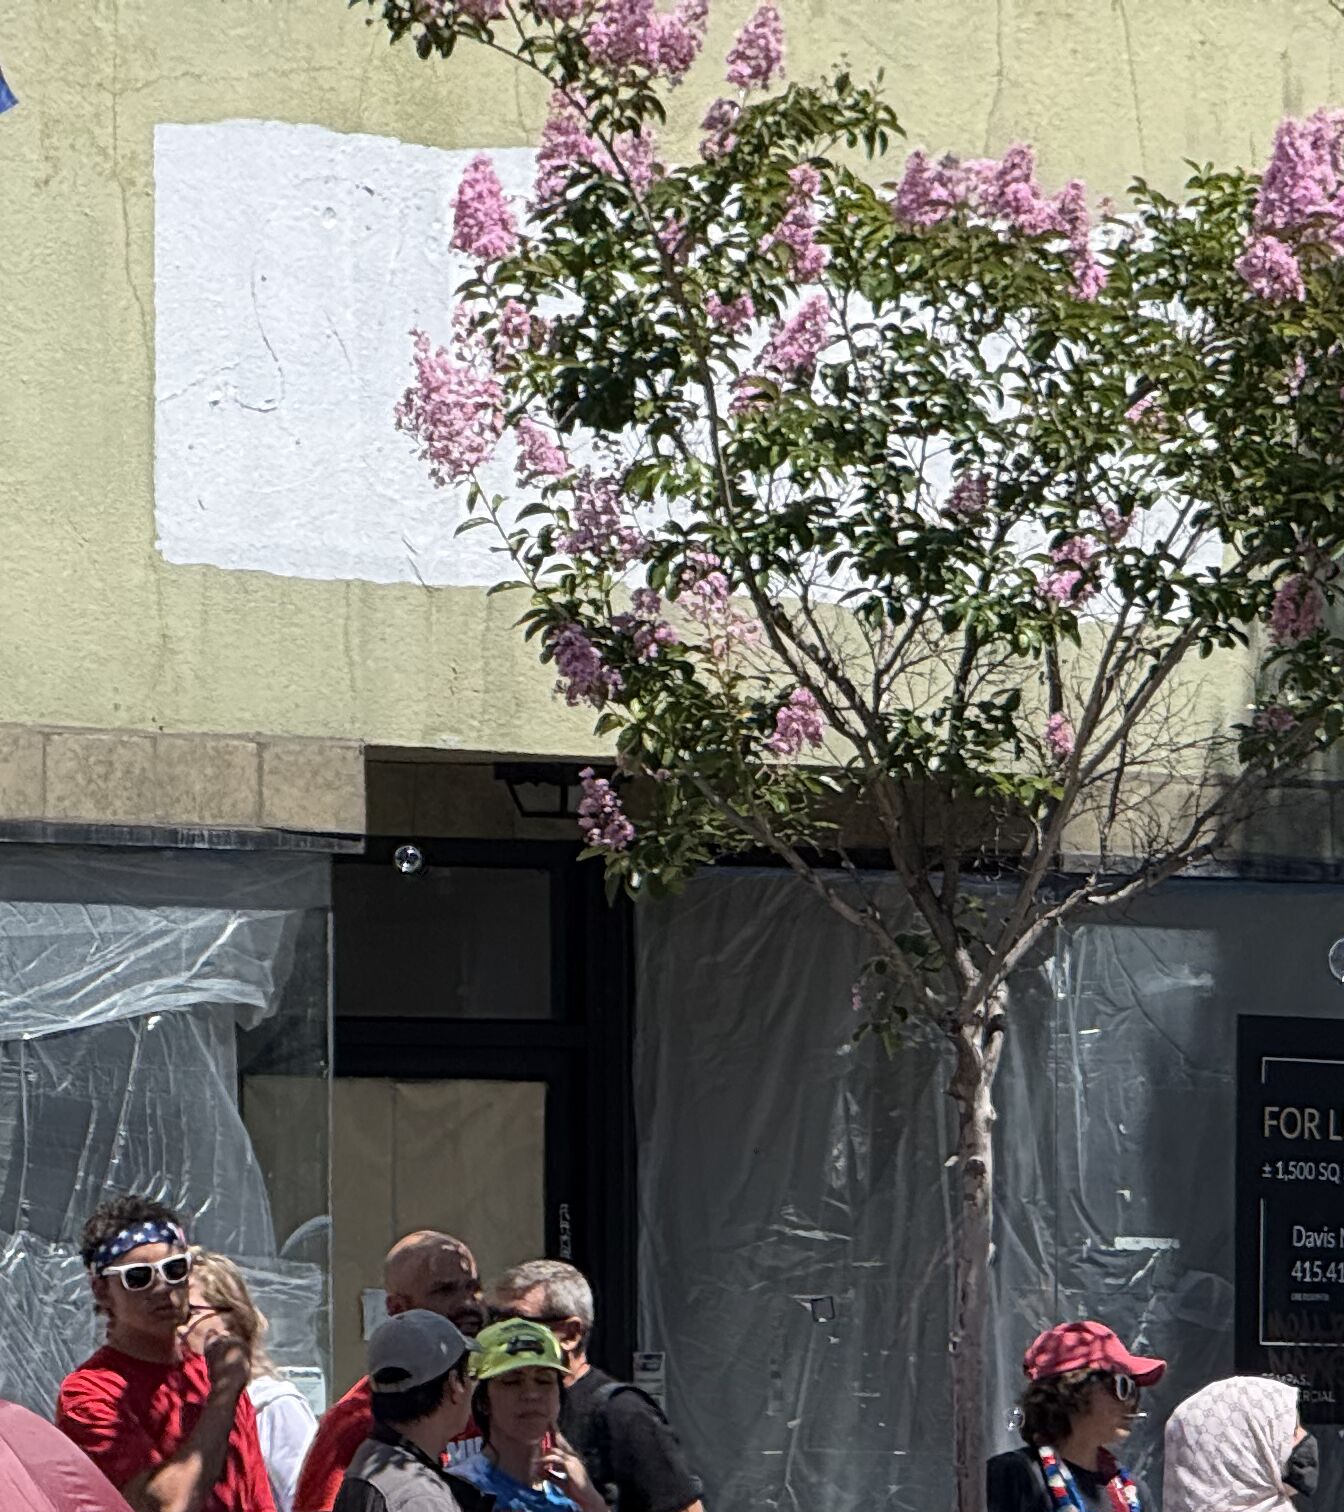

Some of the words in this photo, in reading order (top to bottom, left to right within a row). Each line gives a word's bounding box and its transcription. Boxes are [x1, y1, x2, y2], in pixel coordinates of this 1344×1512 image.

[1263, 1106, 1321, 1140] FOR
[1275, 1160, 1316, 1181] 1,500
[1319, 1162, 1341, 1184] SQ
[1292, 1225, 1336, 1249] Davis
